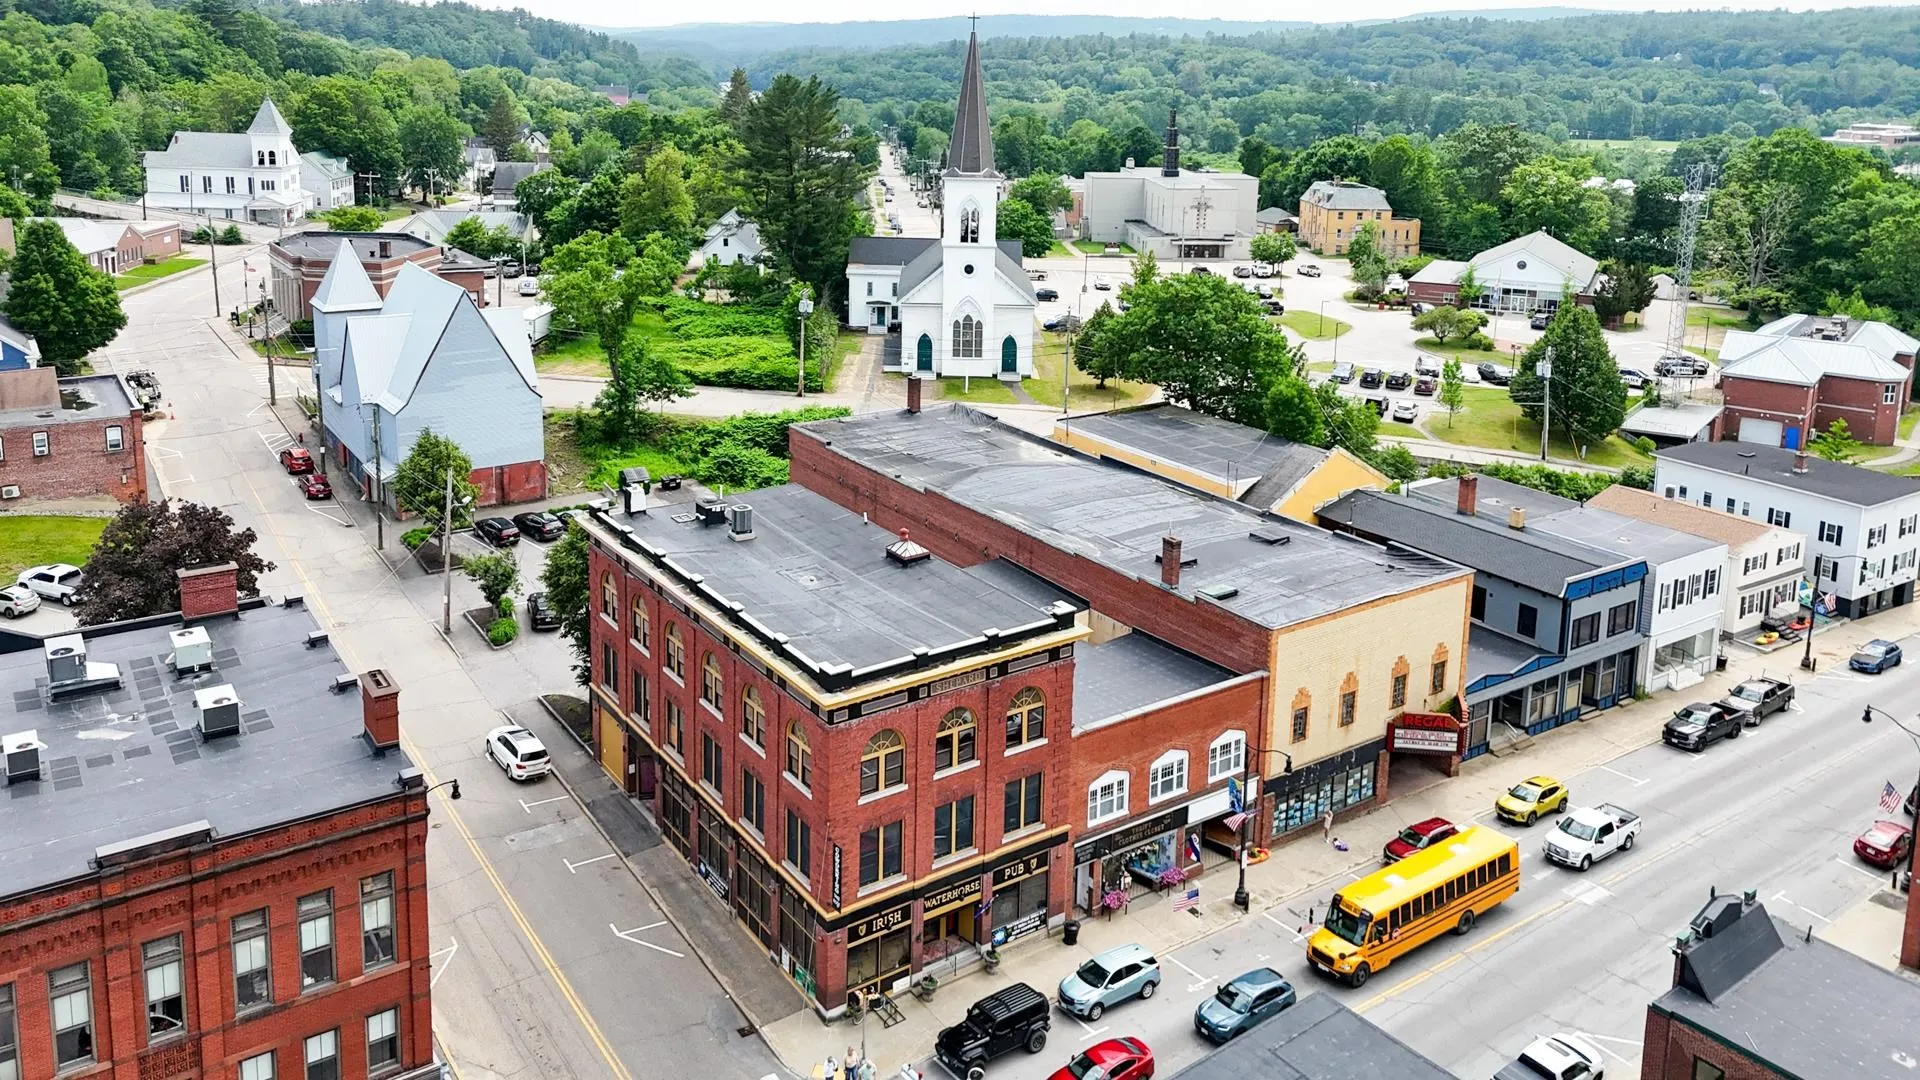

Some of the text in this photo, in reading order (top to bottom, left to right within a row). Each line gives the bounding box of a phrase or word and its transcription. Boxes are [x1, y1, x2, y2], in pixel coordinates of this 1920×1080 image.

[1404, 715, 1450, 728] REGAL
[1004, 863, 1024, 880] PUB
[924, 880, 981, 909] WATERHORSE
[872, 910, 902, 931] IRISH
